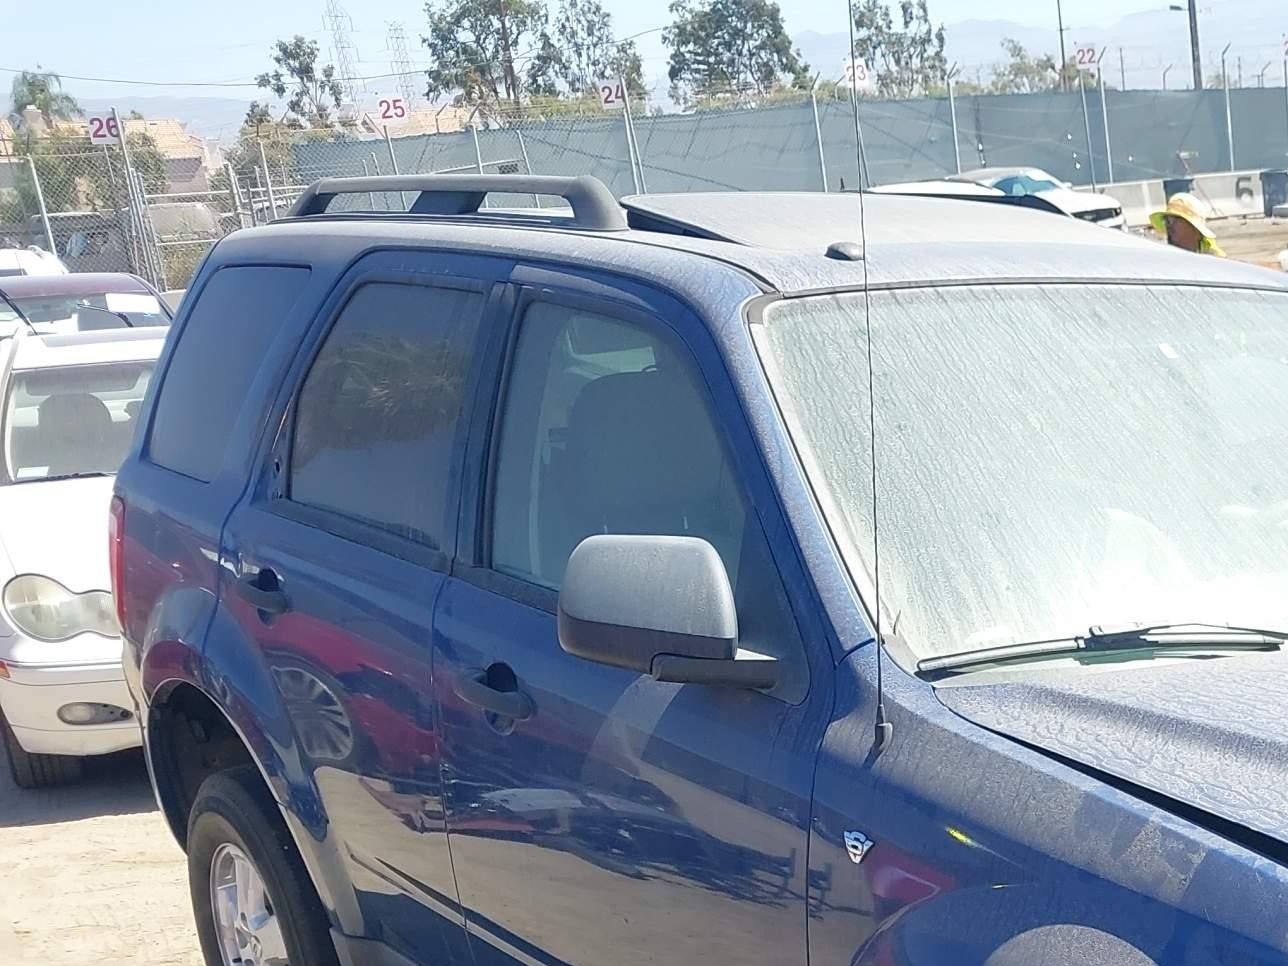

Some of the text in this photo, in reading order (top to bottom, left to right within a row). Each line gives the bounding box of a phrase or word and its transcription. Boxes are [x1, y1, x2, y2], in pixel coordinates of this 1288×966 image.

[1077, 48, 1096, 65] 22
[846, 64, 866, 82] 23
[601, 84, 624, 104] 24
[379, 99, 405, 119] 25
[89, 117, 120, 139] 26
